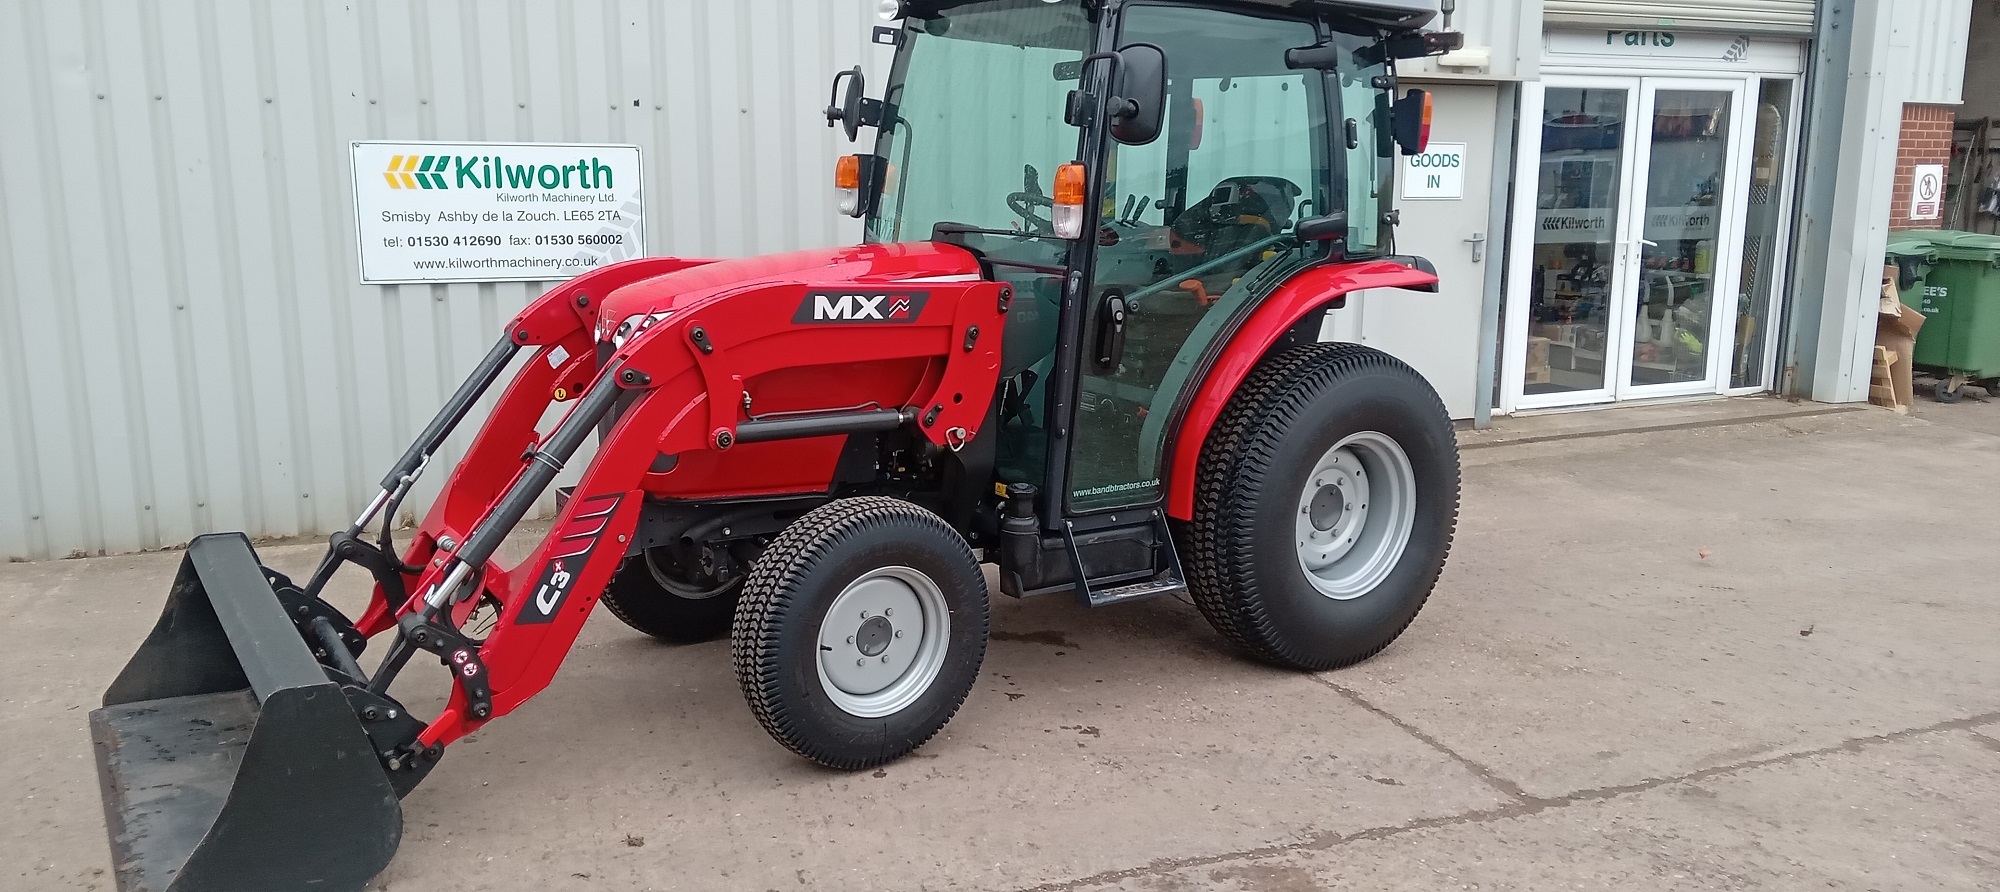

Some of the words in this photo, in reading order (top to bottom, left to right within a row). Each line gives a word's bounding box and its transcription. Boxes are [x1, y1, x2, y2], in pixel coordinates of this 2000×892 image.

[1410, 153, 1460, 168] GOODS
[455, 156, 613, 189] Kilworth
[1427, 174, 1440, 189] IN
[496, 193, 539, 202] Kilworth
[542, 193, 595, 204] Machinery
[598, 193, 617, 202] Ltd.
[381, 210, 431, 225] Smisby
[437, 210, 478, 225] Ashby
[482, 210, 499, 222] de
[502, 210, 513, 222] la
[516, 210, 560, 222] Zouch.
[563, 210, 595, 221] LE65
[597, 210, 622, 221] 2TA
[1560, 216, 1605, 230] Kilworth
[383, 236, 403, 248] tel:
[407, 236, 449, 247] 01530
[453, 235, 502, 246] 412690
[509, 235, 531, 246] fax:
[535, 235, 574, 245] 01530
[577, 234, 623, 245] 560002
[413, 255, 598, 270] www.kilworthmachinery.co.uk
[814, 295, 886, 320] MX
[1072, 478, 1160, 498] www.bandbtractors.co.uk
